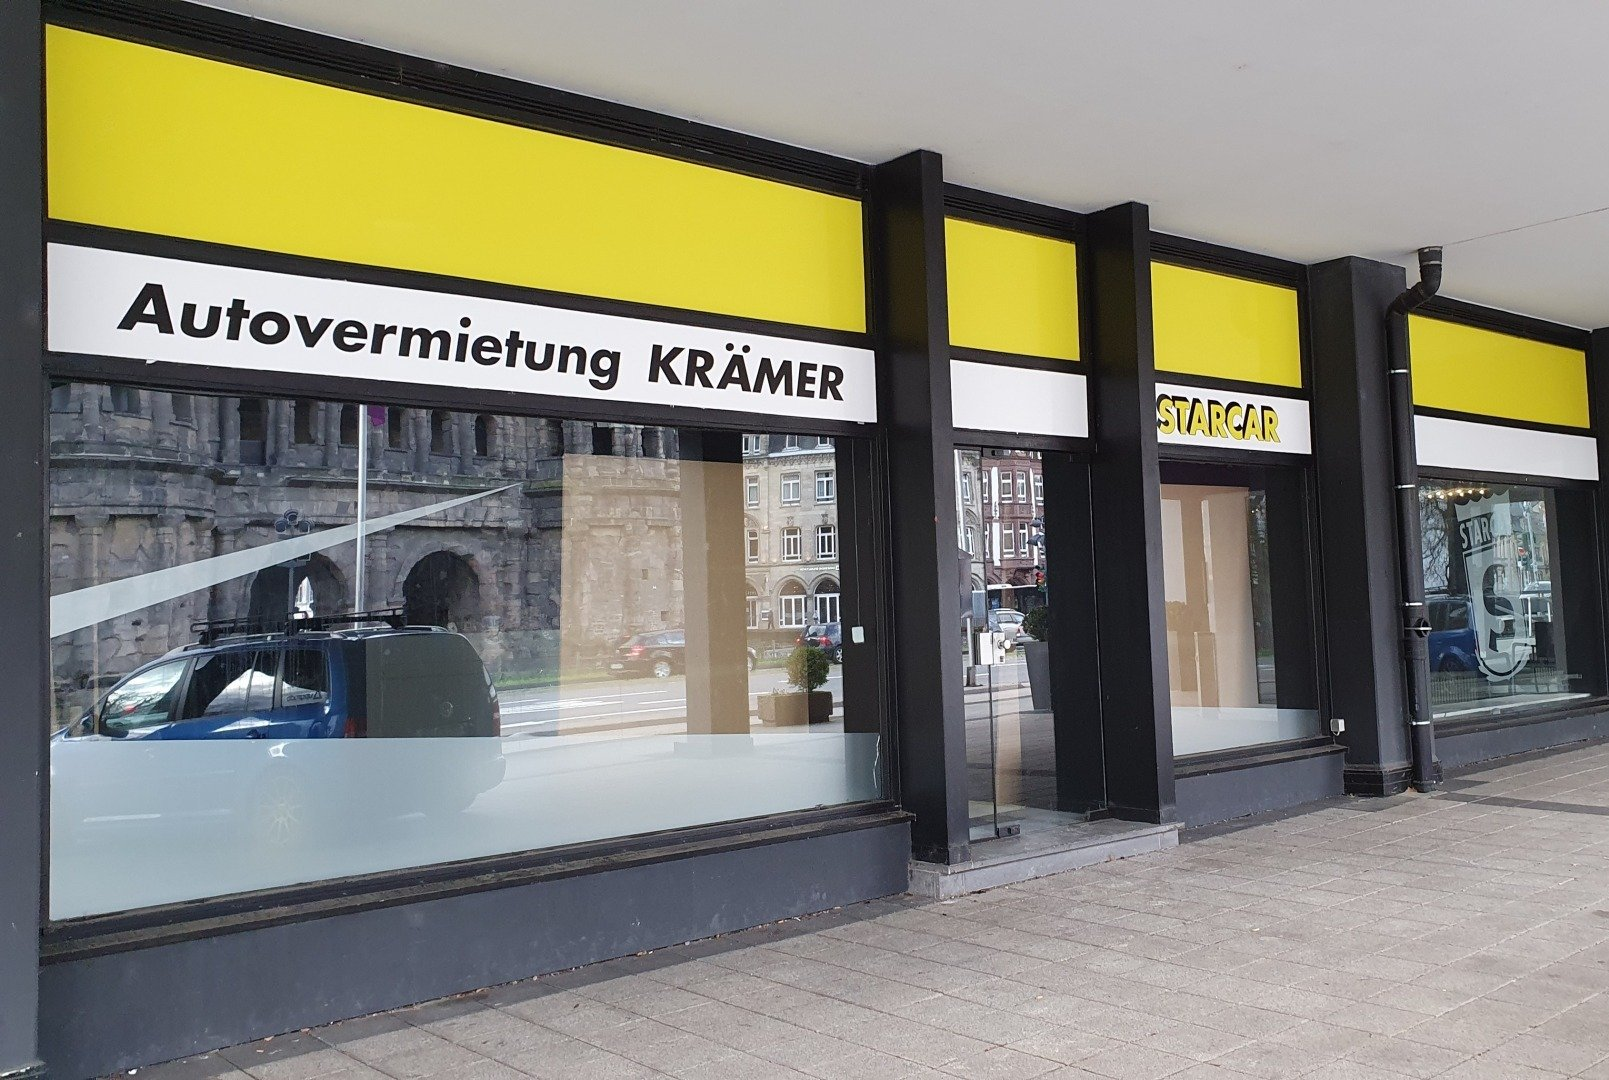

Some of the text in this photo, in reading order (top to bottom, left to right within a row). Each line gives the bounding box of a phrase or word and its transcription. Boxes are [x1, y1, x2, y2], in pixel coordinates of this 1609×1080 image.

[117, 283, 844, 402] Autovermietung KRÄMER
[1157, 393, 1281, 443] STARCAR
